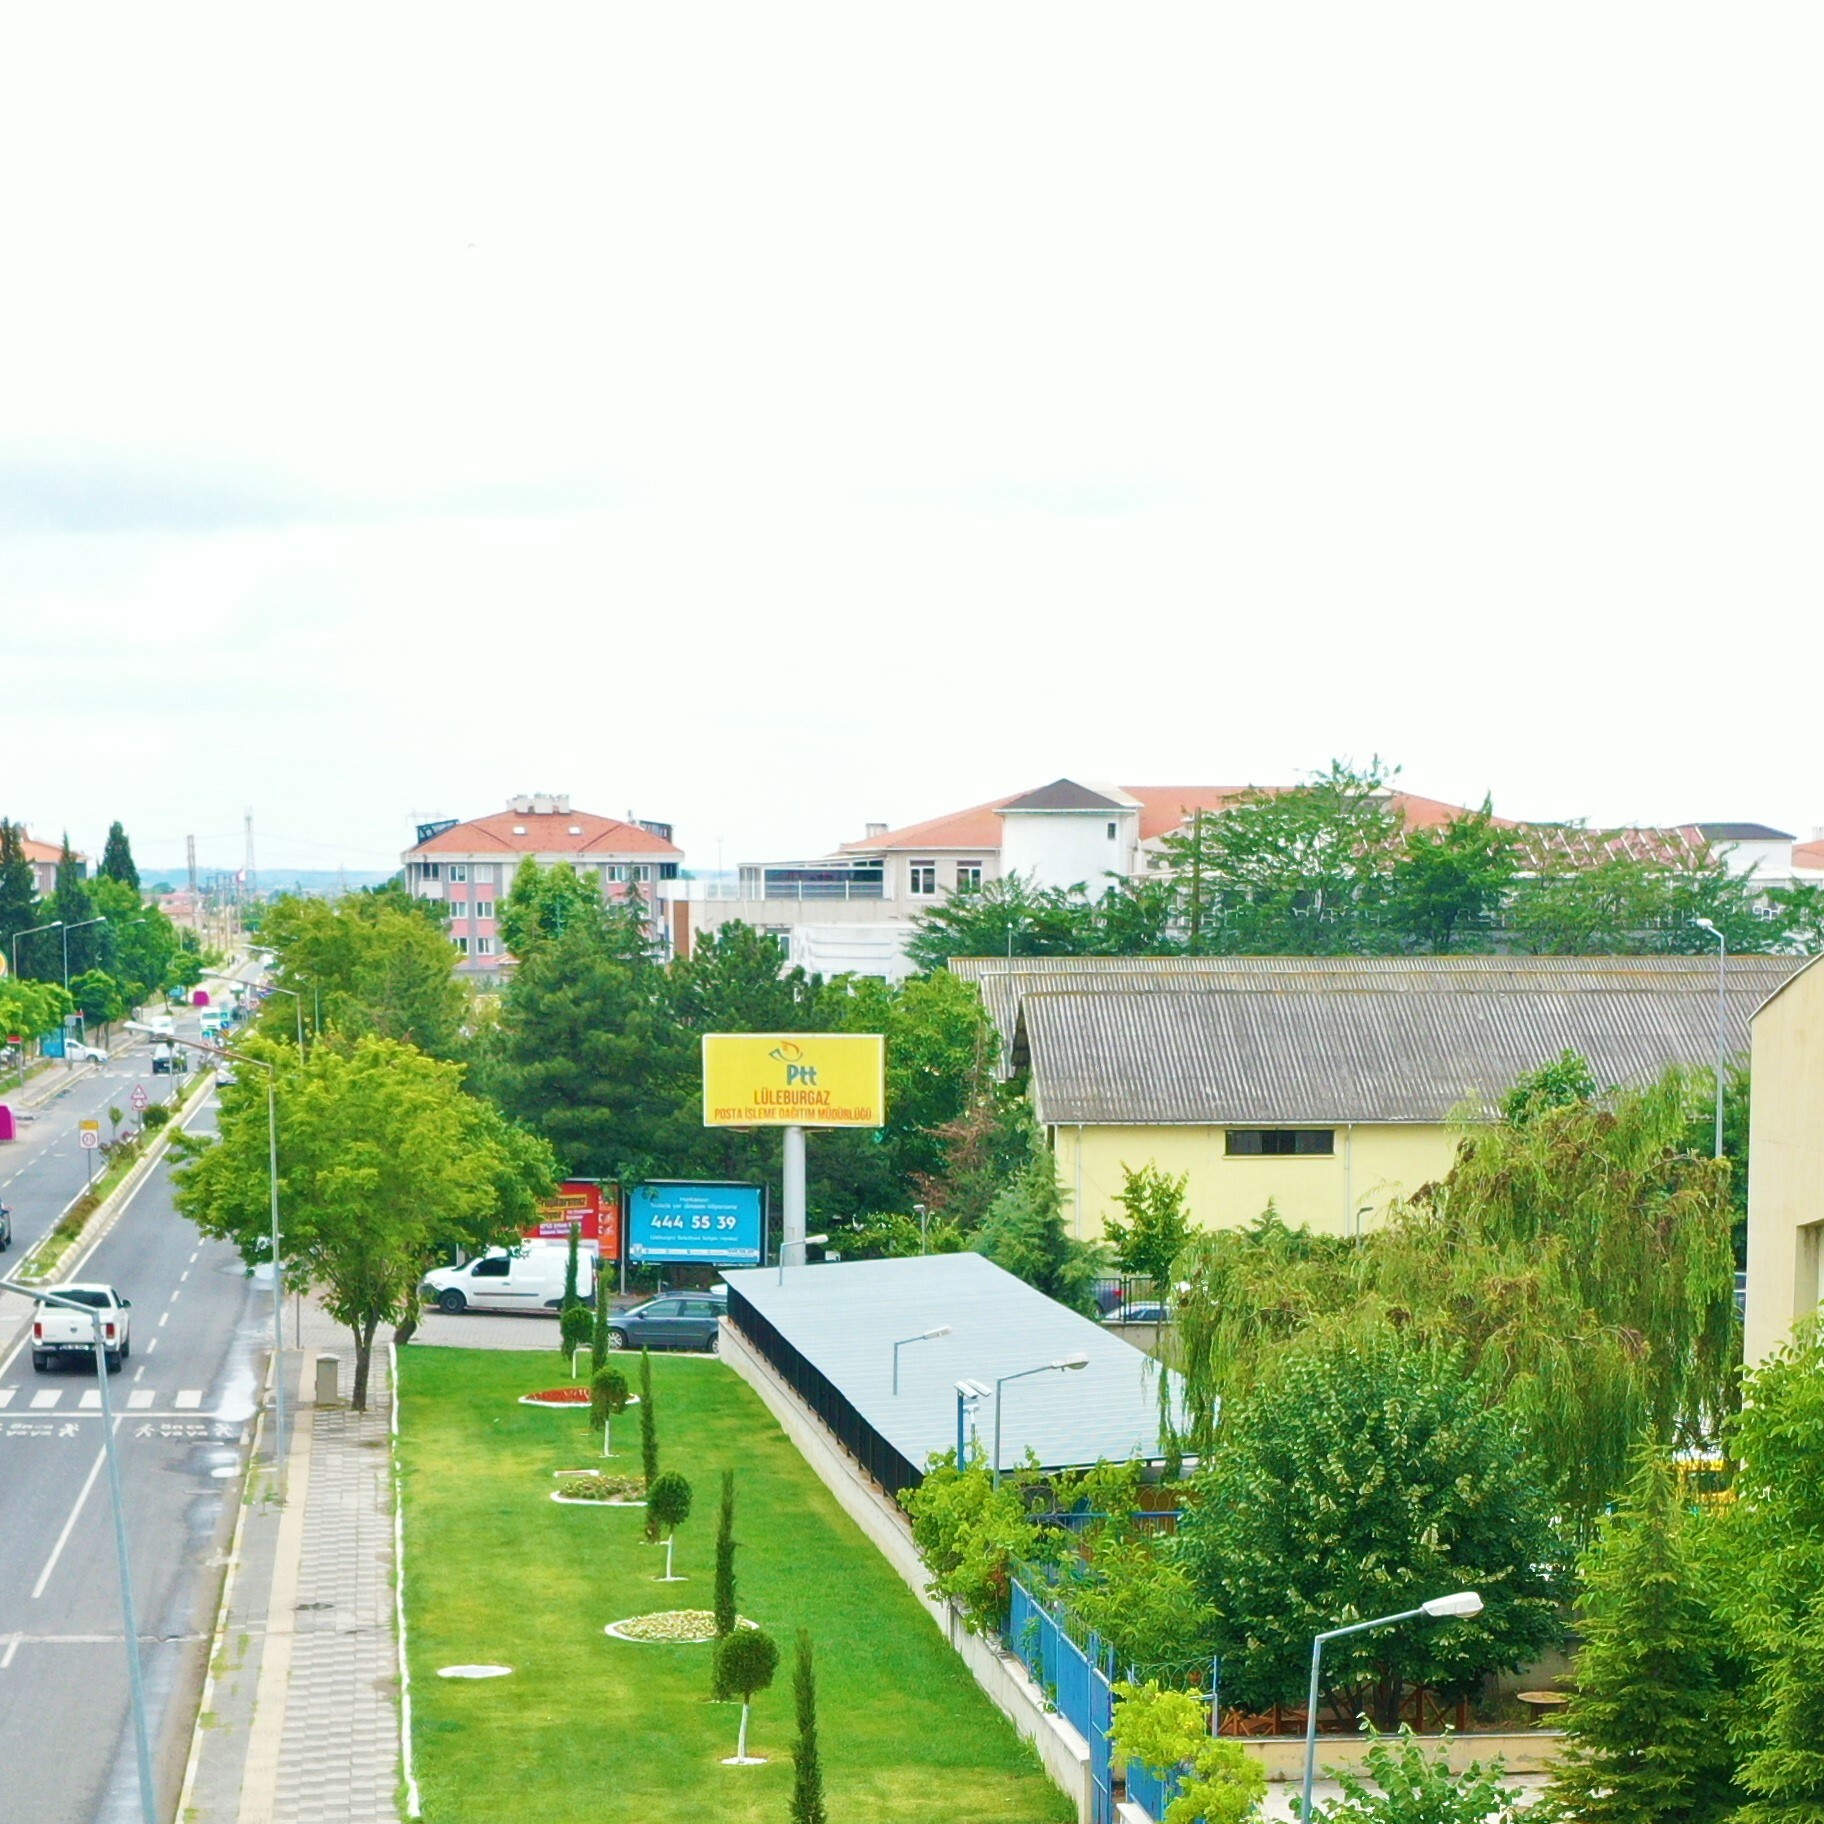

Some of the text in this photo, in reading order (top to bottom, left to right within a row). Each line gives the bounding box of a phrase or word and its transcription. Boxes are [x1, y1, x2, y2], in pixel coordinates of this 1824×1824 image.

[786, 1064, 817, 1086] Ptt
[754, 1087, 831, 1105] LÜLEBURGAZ
[714, 1108, 743, 1120] POSTA
[650, 1214, 737, 1230] 444 55 39
